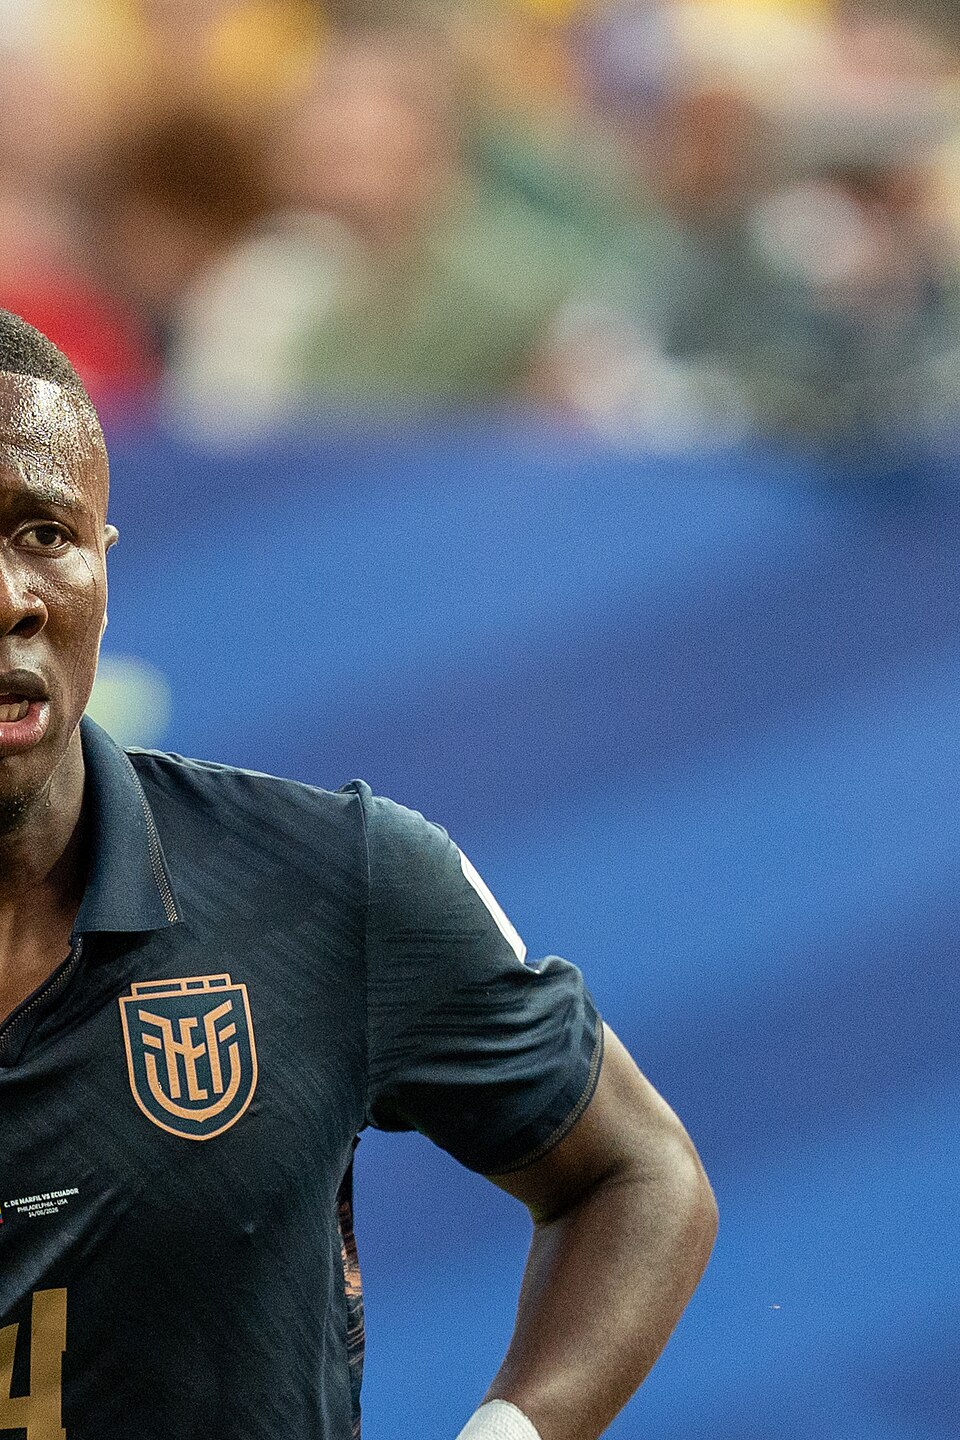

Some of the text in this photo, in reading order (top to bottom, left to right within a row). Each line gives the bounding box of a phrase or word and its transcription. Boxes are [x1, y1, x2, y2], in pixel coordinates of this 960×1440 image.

[19, 1196, 42, 1204] MARFIL
[51, 1188, 79, 1198] ECUADOR
[17, 1202, 54, 1213] PHILADELPHIA
